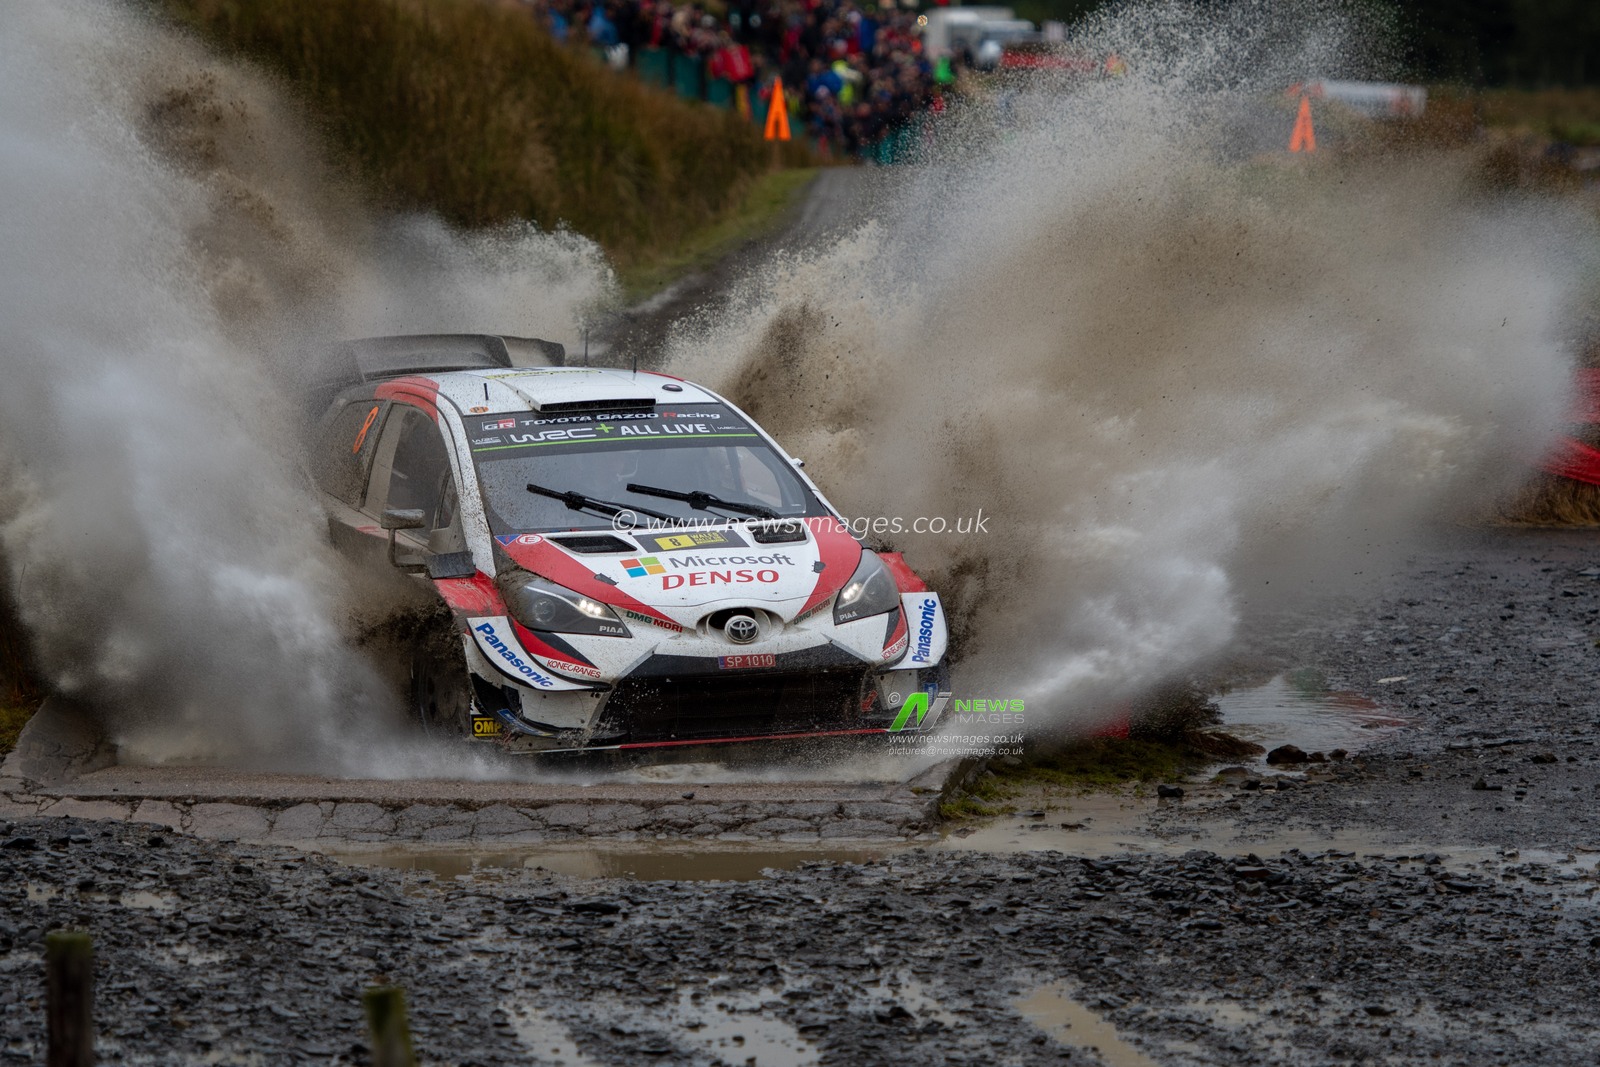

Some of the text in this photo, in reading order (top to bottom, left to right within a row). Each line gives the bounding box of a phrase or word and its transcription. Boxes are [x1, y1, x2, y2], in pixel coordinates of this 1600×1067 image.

[520, 411, 721, 426] TOYOTA GAZOO Racing
[620, 423, 711, 436] ALL LIVE
[669, 537, 682, 547] 8
[668, 553, 795, 569] Microsoft
[661, 569, 780, 591] DENSO
[811, 598, 831, 616] MORI
[626, 610, 683, 633] DMG MORI
[839, 610, 858, 621] PIAA
[599, 625, 624, 634] PIAA
[912, 598, 937, 664] Panasonic
[475, 622, 554, 688] Panasonic
[726, 654, 773, 667] SP 1010
[546, 659, 602, 679] KONECRANES
